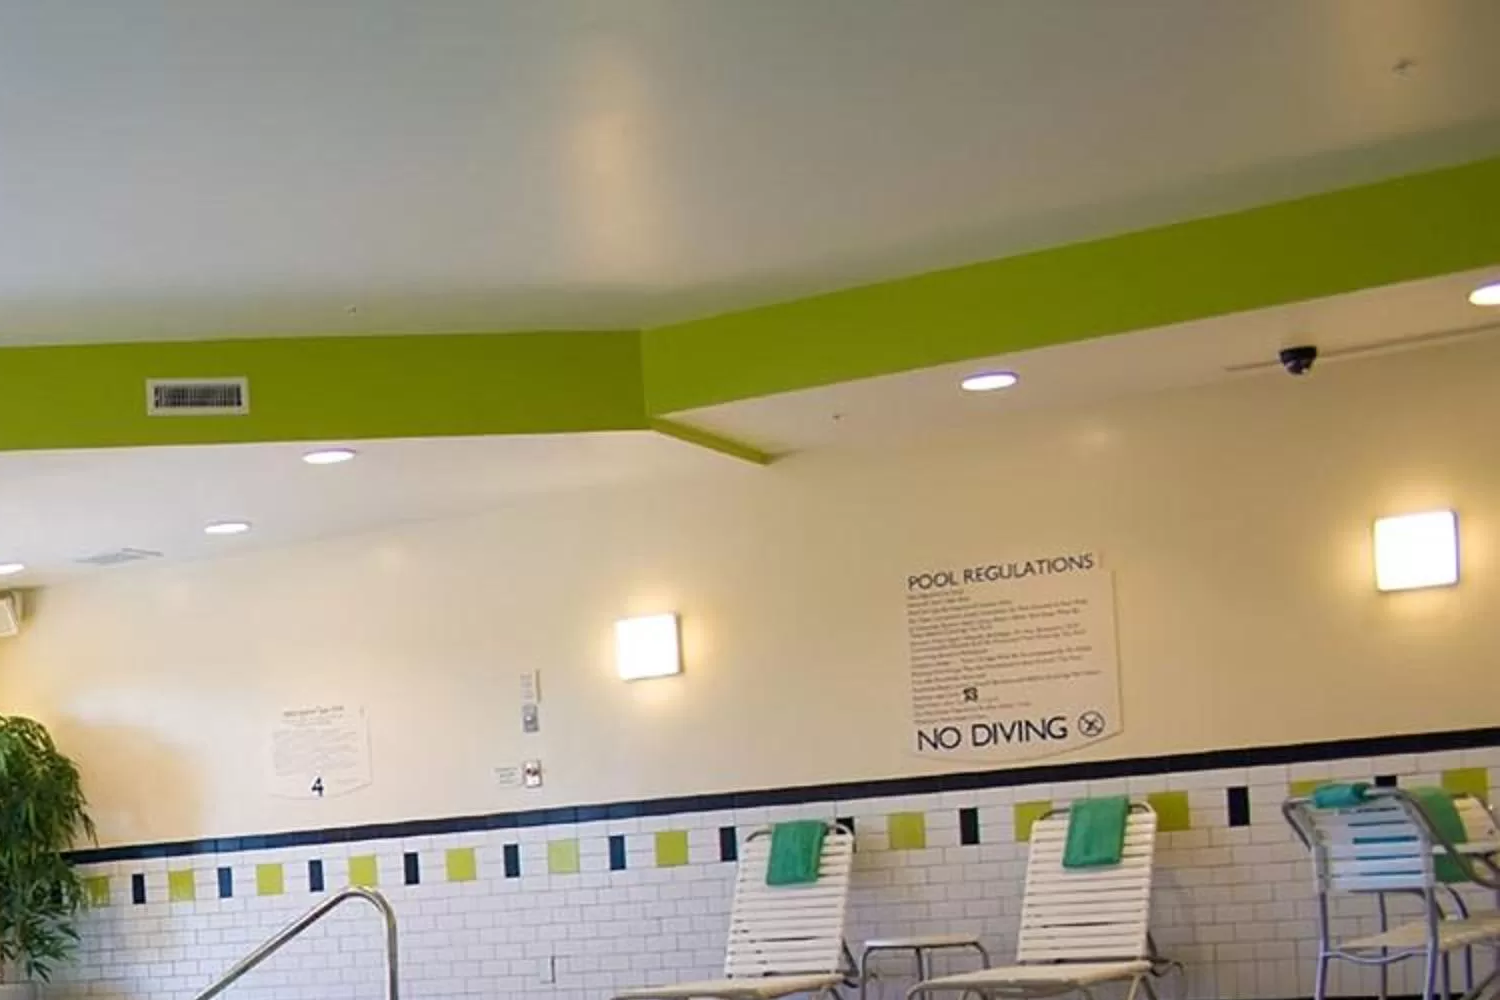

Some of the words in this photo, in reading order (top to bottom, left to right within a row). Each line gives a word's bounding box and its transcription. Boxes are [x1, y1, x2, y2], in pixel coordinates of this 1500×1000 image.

[907, 571, 958, 590] POOL
[963, 553, 1094, 583] REGULATIONS
[918, 727, 962, 750] NO
[972, 716, 1067, 747] DIVING
[311, 777, 324, 797] 4
